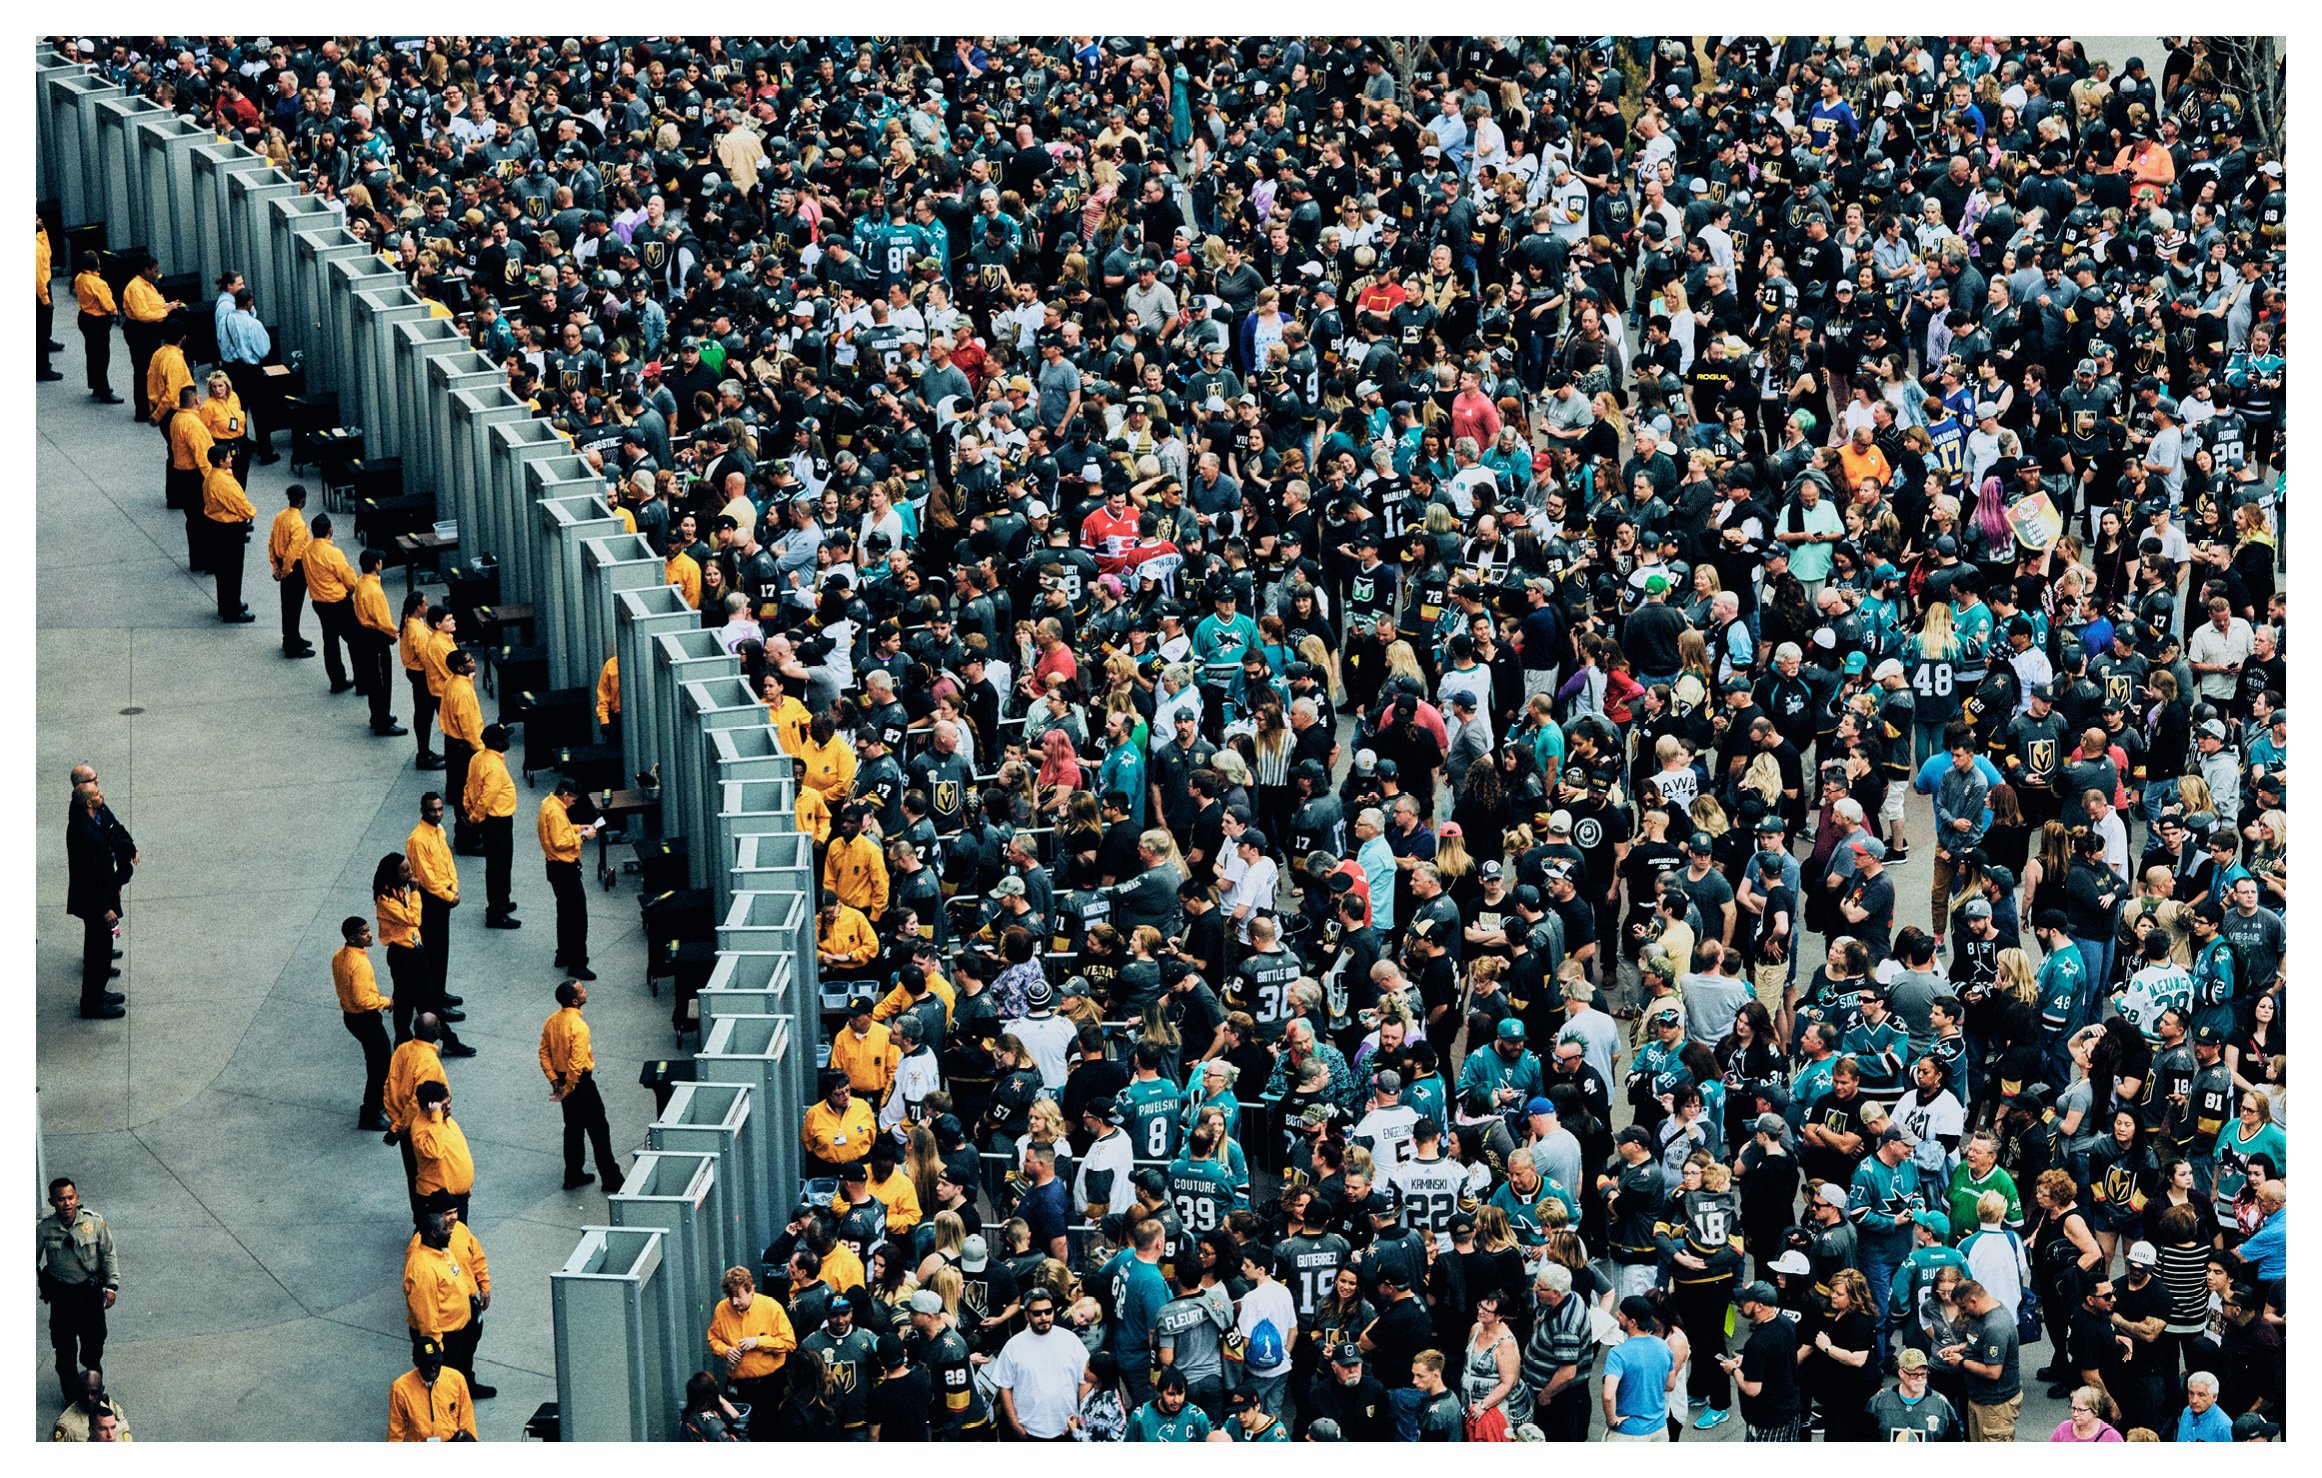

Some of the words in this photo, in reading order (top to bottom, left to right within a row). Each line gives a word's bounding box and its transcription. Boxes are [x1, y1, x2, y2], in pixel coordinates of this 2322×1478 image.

[1922, 94, 1934, 104] 17
[1697, 373, 1729, 381] ROGUE
[2218, 431, 2239, 441] FLEURY
[1939, 441, 1965, 473] 17
[2212, 441, 2245, 473] 29
[760, 584, 776, 598] 17
[1427, 590, 1443, 604] 72
[2153, 614, 2167, 628] 17
[1912, 663, 1953, 697] 48
[1969, 698, 1985, 714] 29
[884, 728, 902, 744] 87
[877, 783, 892, 799] 17
[1294, 835, 1310, 850] 17
[2229, 932, 2261, 942] VEGAS
[1256, 967, 1286, 983] BATTLE
[2053, 995, 2072, 1010] 48
[2174, 1078, 2188, 1094] 18
[1138, 1098, 1178, 1117] PAVELSKI
[2205, 1093, 2223, 1111] 81
[910, 1105, 922, 1121] 71
[993, 1103, 1011, 1120] 57
[1148, 1116, 1167, 1158] 8
[1174, 1178, 1217, 1194] COUTURE
[1411, 1178, 1448, 1191] KAMINSKI
[1850, 1184, 1866, 1201] 27
[1174, 1196, 1217, 1232] 39
[1404, 1193, 1457, 1235] 22
[1698, 1201, 1718, 1212] NEAL
[1694, 1212, 1727, 1246] 18
[1296, 1252, 1338, 1268] GUTIERREZ
[2133, 1250, 2150, 1261] VEGAS
[1164, 1306, 1204, 1331] FLEURY
[1186, 1424, 1194, 1438] C
